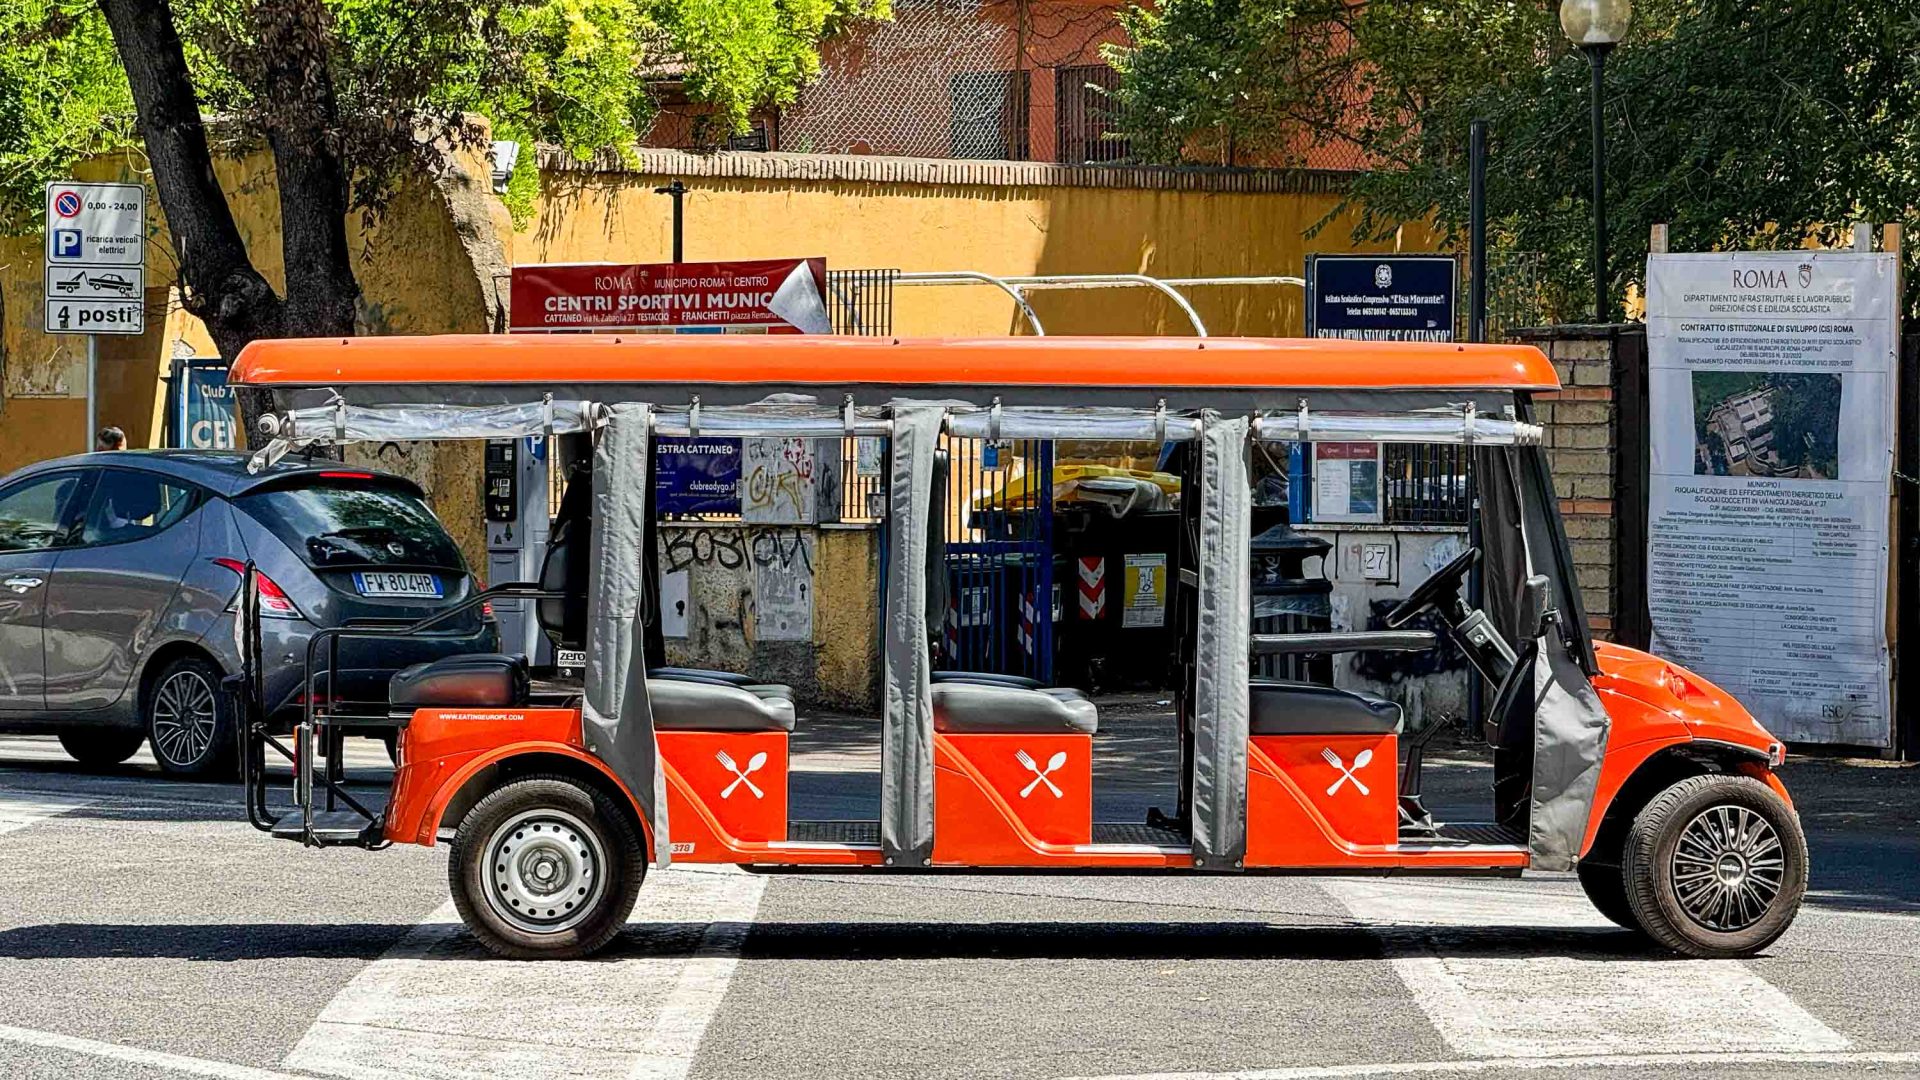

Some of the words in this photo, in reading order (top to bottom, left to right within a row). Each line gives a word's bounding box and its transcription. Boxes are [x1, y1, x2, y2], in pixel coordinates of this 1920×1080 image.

[88, 202, 106, 210] 0,00
[114, 202, 138, 211] 24,00
[58, 231, 78, 254] P
[86, 236, 114, 244] ricarica
[116, 236, 138, 244] veicoli
[595, 276, 633, 290] ROMA
[654, 278, 698, 289] MUNICIPIO
[700, 278, 726, 288] ROMA
[734, 276, 768, 287] CENTRO
[1733, 270, 1788, 288] ROMA
[544, 296, 612, 312] CENTRI
[618, 294, 700, 310] SPORTIVI
[707, 292, 776, 308] MUNIC
[58, 306, 70, 321] 4
[78, 306, 132, 326] posti
[544, 313, 582, 322] CATTANEO
[601, 313, 626, 324] Zabaglia
[638, 313, 669, 322] TESTACCIO
[682, 311, 730, 321] FRANCHETTI
[730, 312, 750, 321] piazza
[1727, 324, 1776, 332] ISTITUZIONALE
[1819, 325, 1832, 334] (CIS)
[202, 384, 225, 397] Club
[687, 445, 732, 454] CATTANEO
[1366, 551, 1385, 570] 27
[364, 574, 385, 591] FW
[389, 574, 434, 592] 804HR
[560, 652, 585, 660] zero
[1822, 704, 1844, 719] FSC
